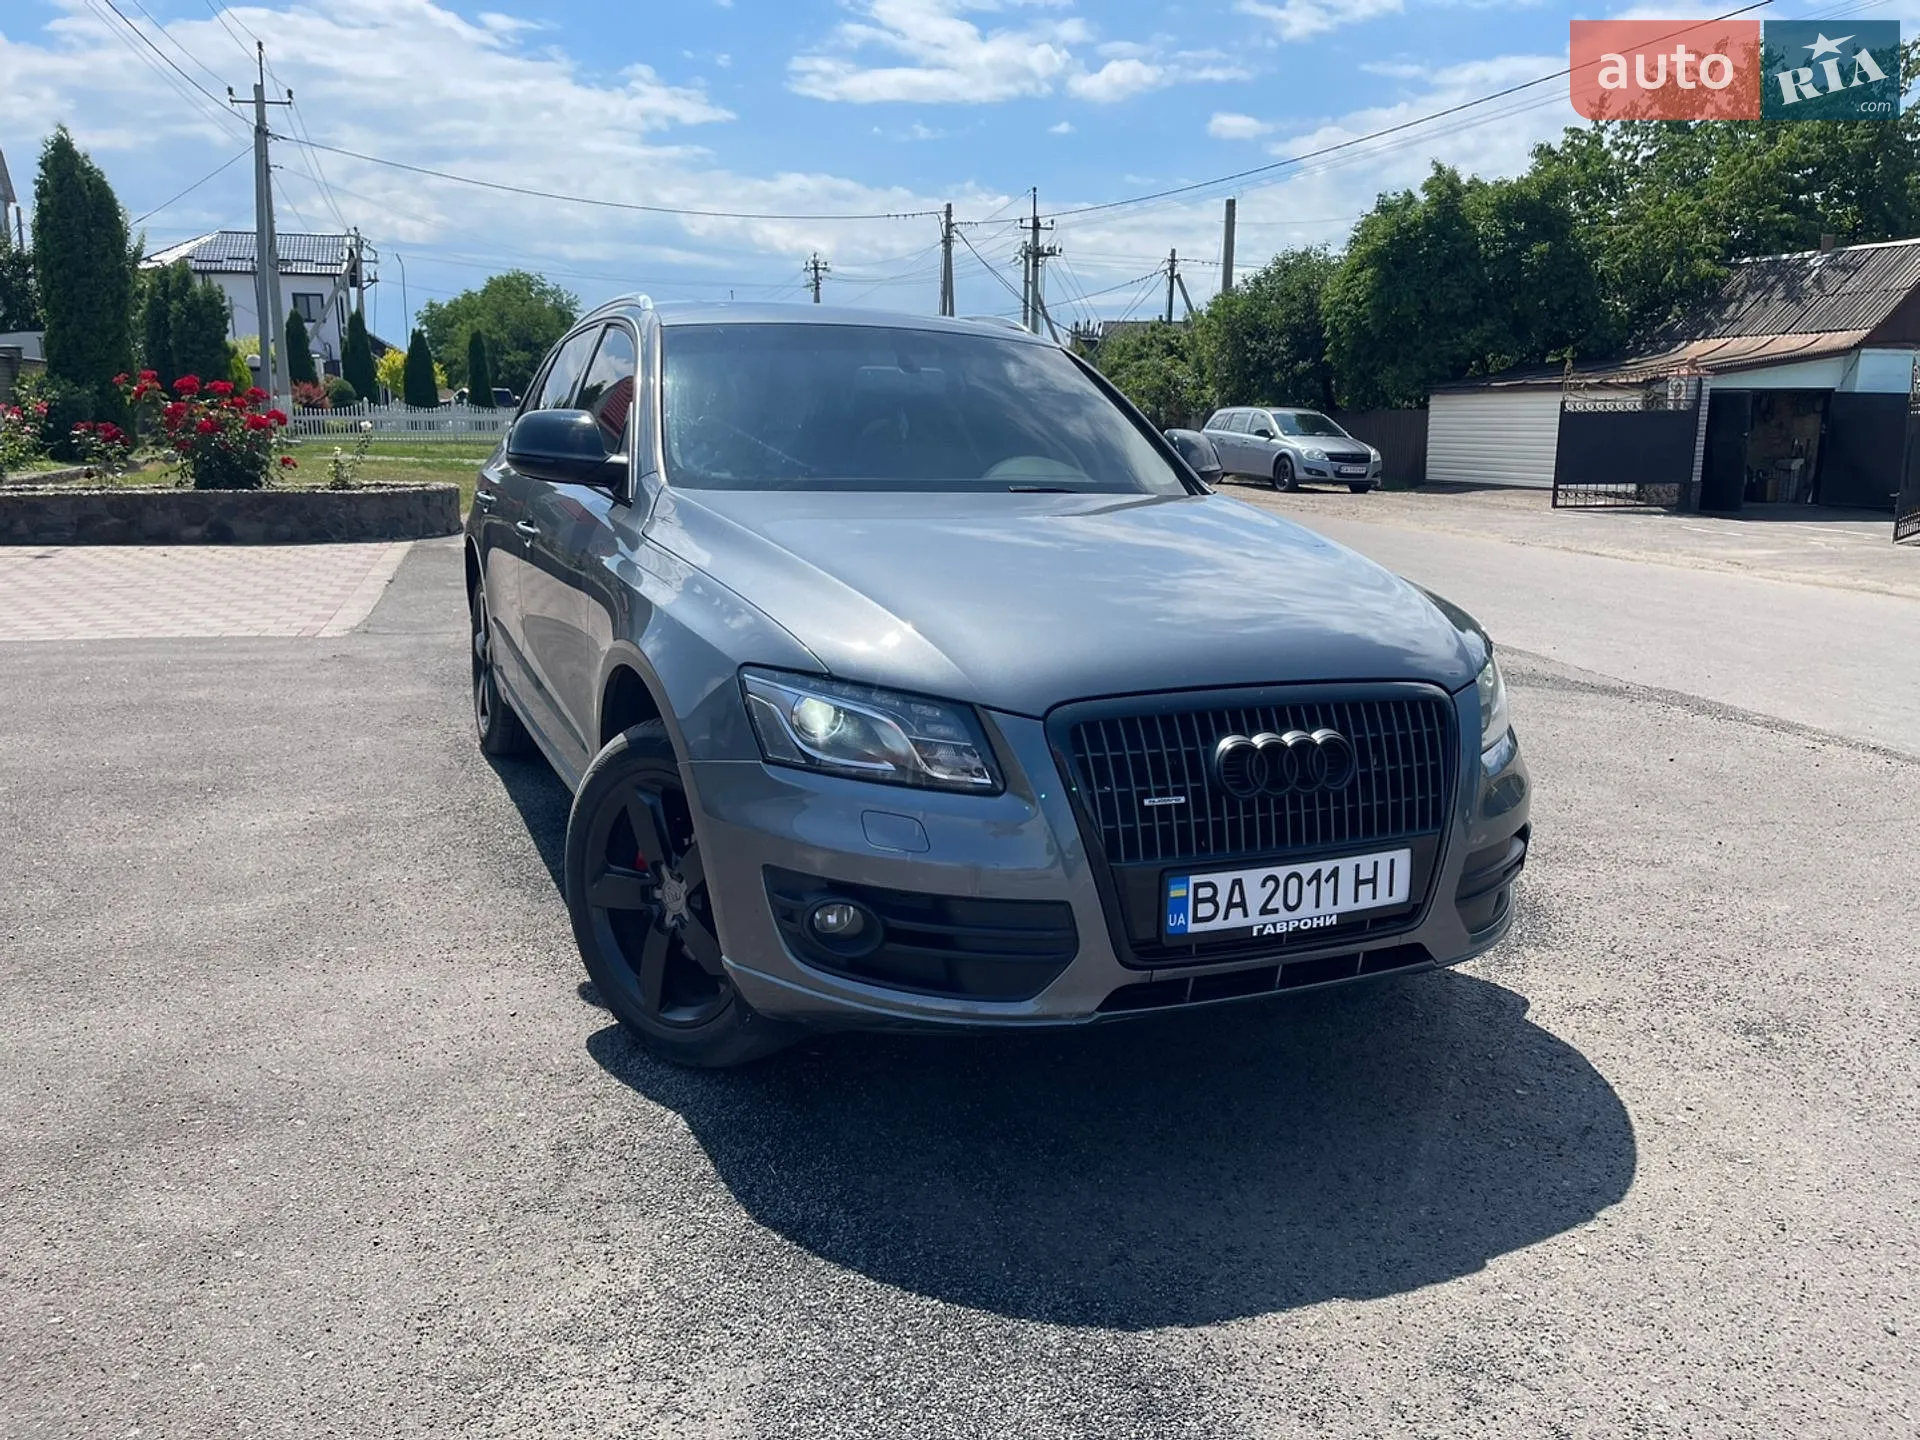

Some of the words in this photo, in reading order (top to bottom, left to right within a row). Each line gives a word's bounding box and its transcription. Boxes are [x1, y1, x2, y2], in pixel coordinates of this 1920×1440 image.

[1191, 877, 1249, 924] BA
[1258, 865, 1340, 916] 2011
[1353, 858, 1395, 904] HI
[1168, 911, 1187, 927] UA
[1252, 914, 1337, 937] ГАВРОНИ
